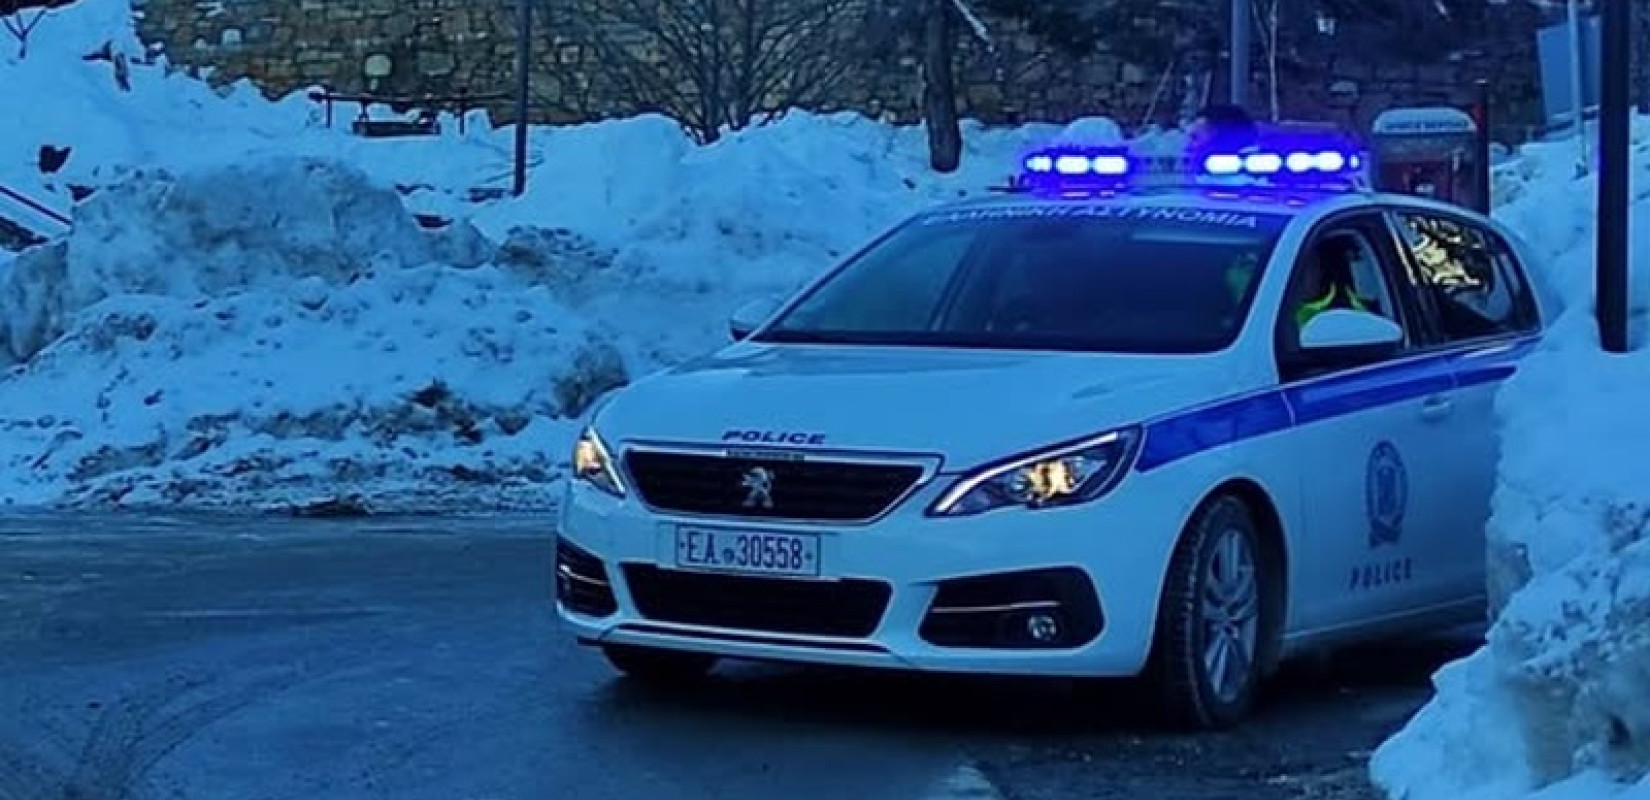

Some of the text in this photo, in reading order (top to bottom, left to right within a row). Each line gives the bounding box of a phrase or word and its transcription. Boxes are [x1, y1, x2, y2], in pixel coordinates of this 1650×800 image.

[1070, 205, 1257, 228] ΑΣΤΥΝΟΜΙΑ
[722, 430, 825, 444] POLICE
[737, 534, 803, 570] 30558
[1350, 556, 1412, 590] POLICE
